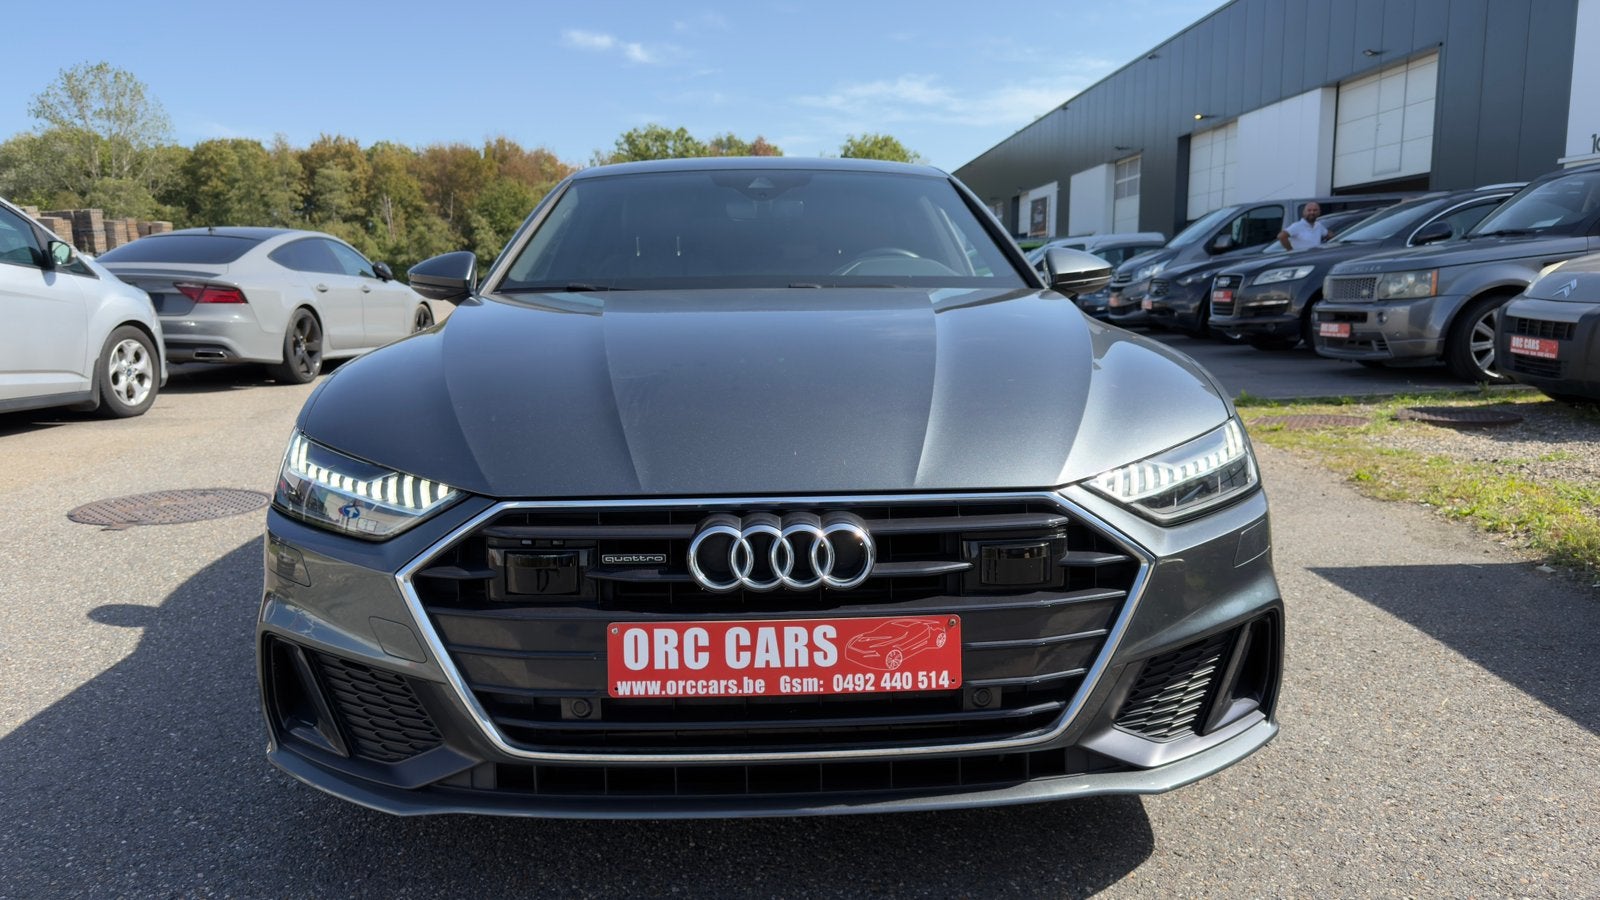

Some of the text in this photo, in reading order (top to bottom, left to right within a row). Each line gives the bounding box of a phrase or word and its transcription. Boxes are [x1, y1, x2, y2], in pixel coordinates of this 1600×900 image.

[604, 555, 664, 563] quattro
[623, 625, 838, 670] ORC CARS
[617, 670, 950, 696] www.orccars.be Gsm: 0492 440 514
